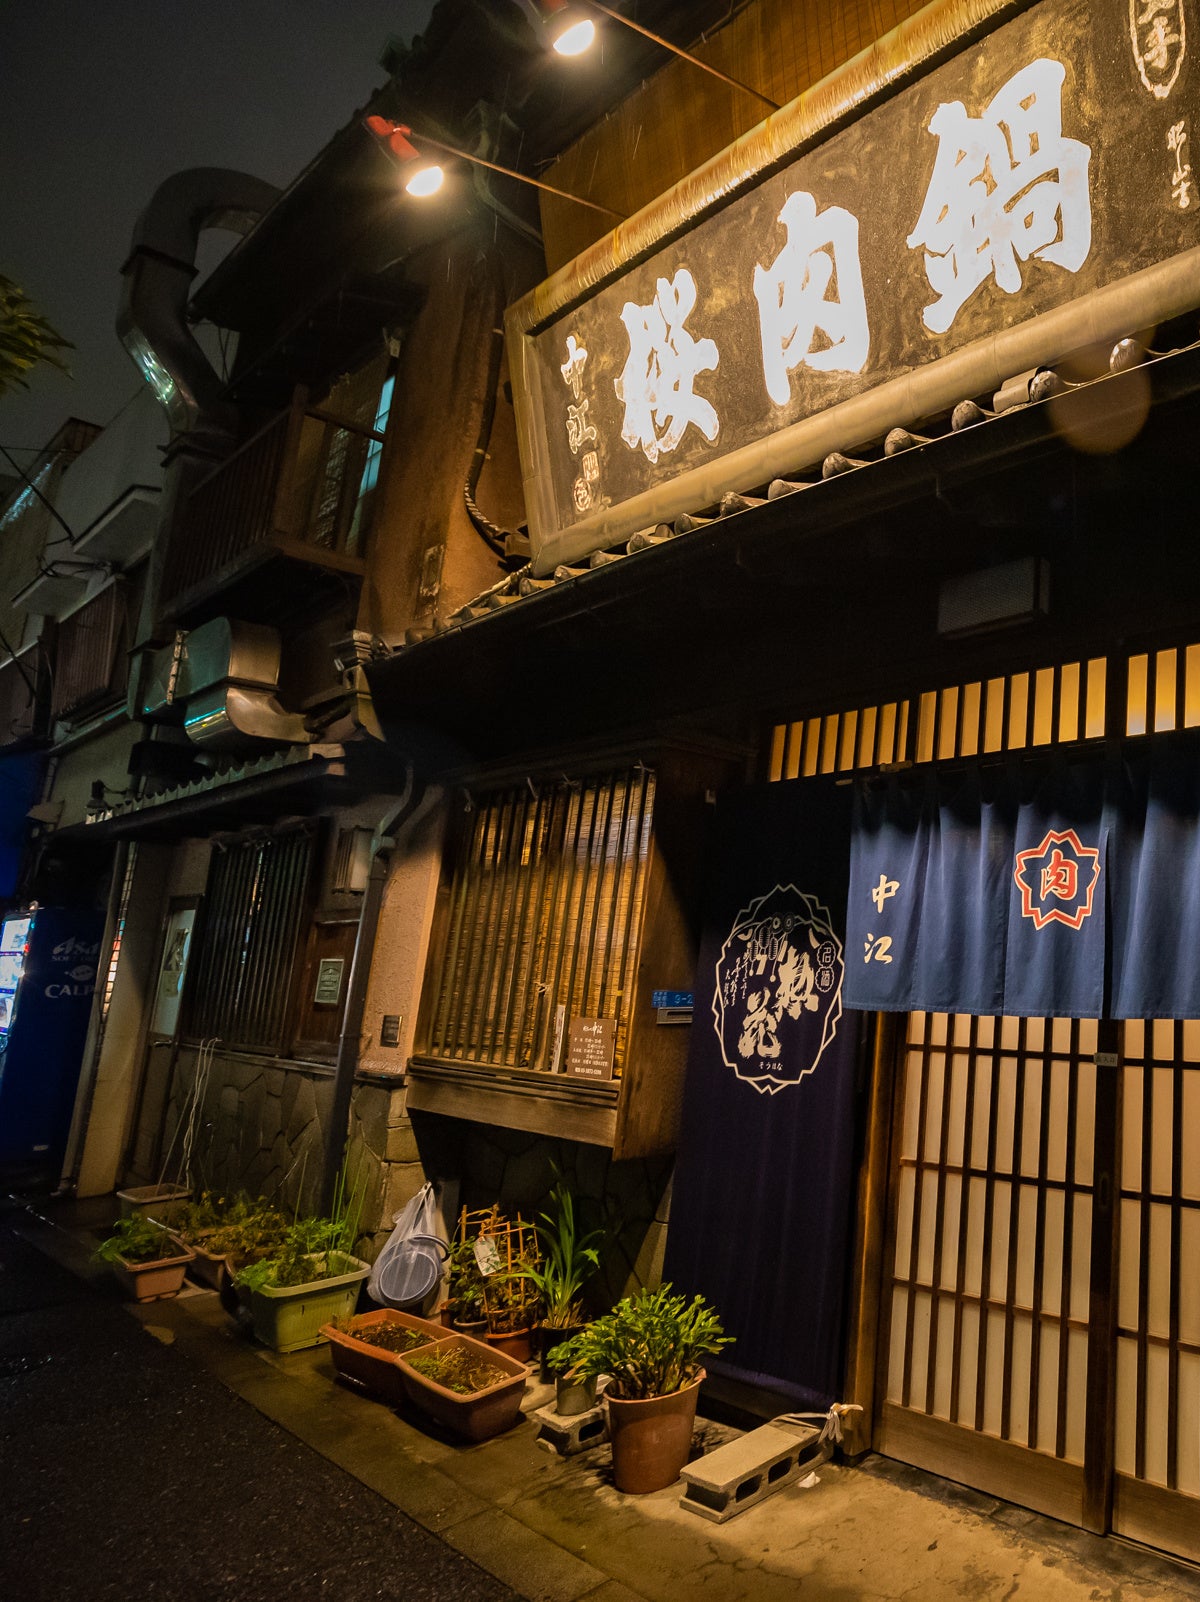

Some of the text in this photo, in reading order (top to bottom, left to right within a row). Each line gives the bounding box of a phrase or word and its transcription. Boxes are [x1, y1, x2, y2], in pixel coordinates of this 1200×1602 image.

[560, 334, 597, 454] 中江
[863, 874, 901, 965] 中江
[1039, 847, 1080, 902] 肉
